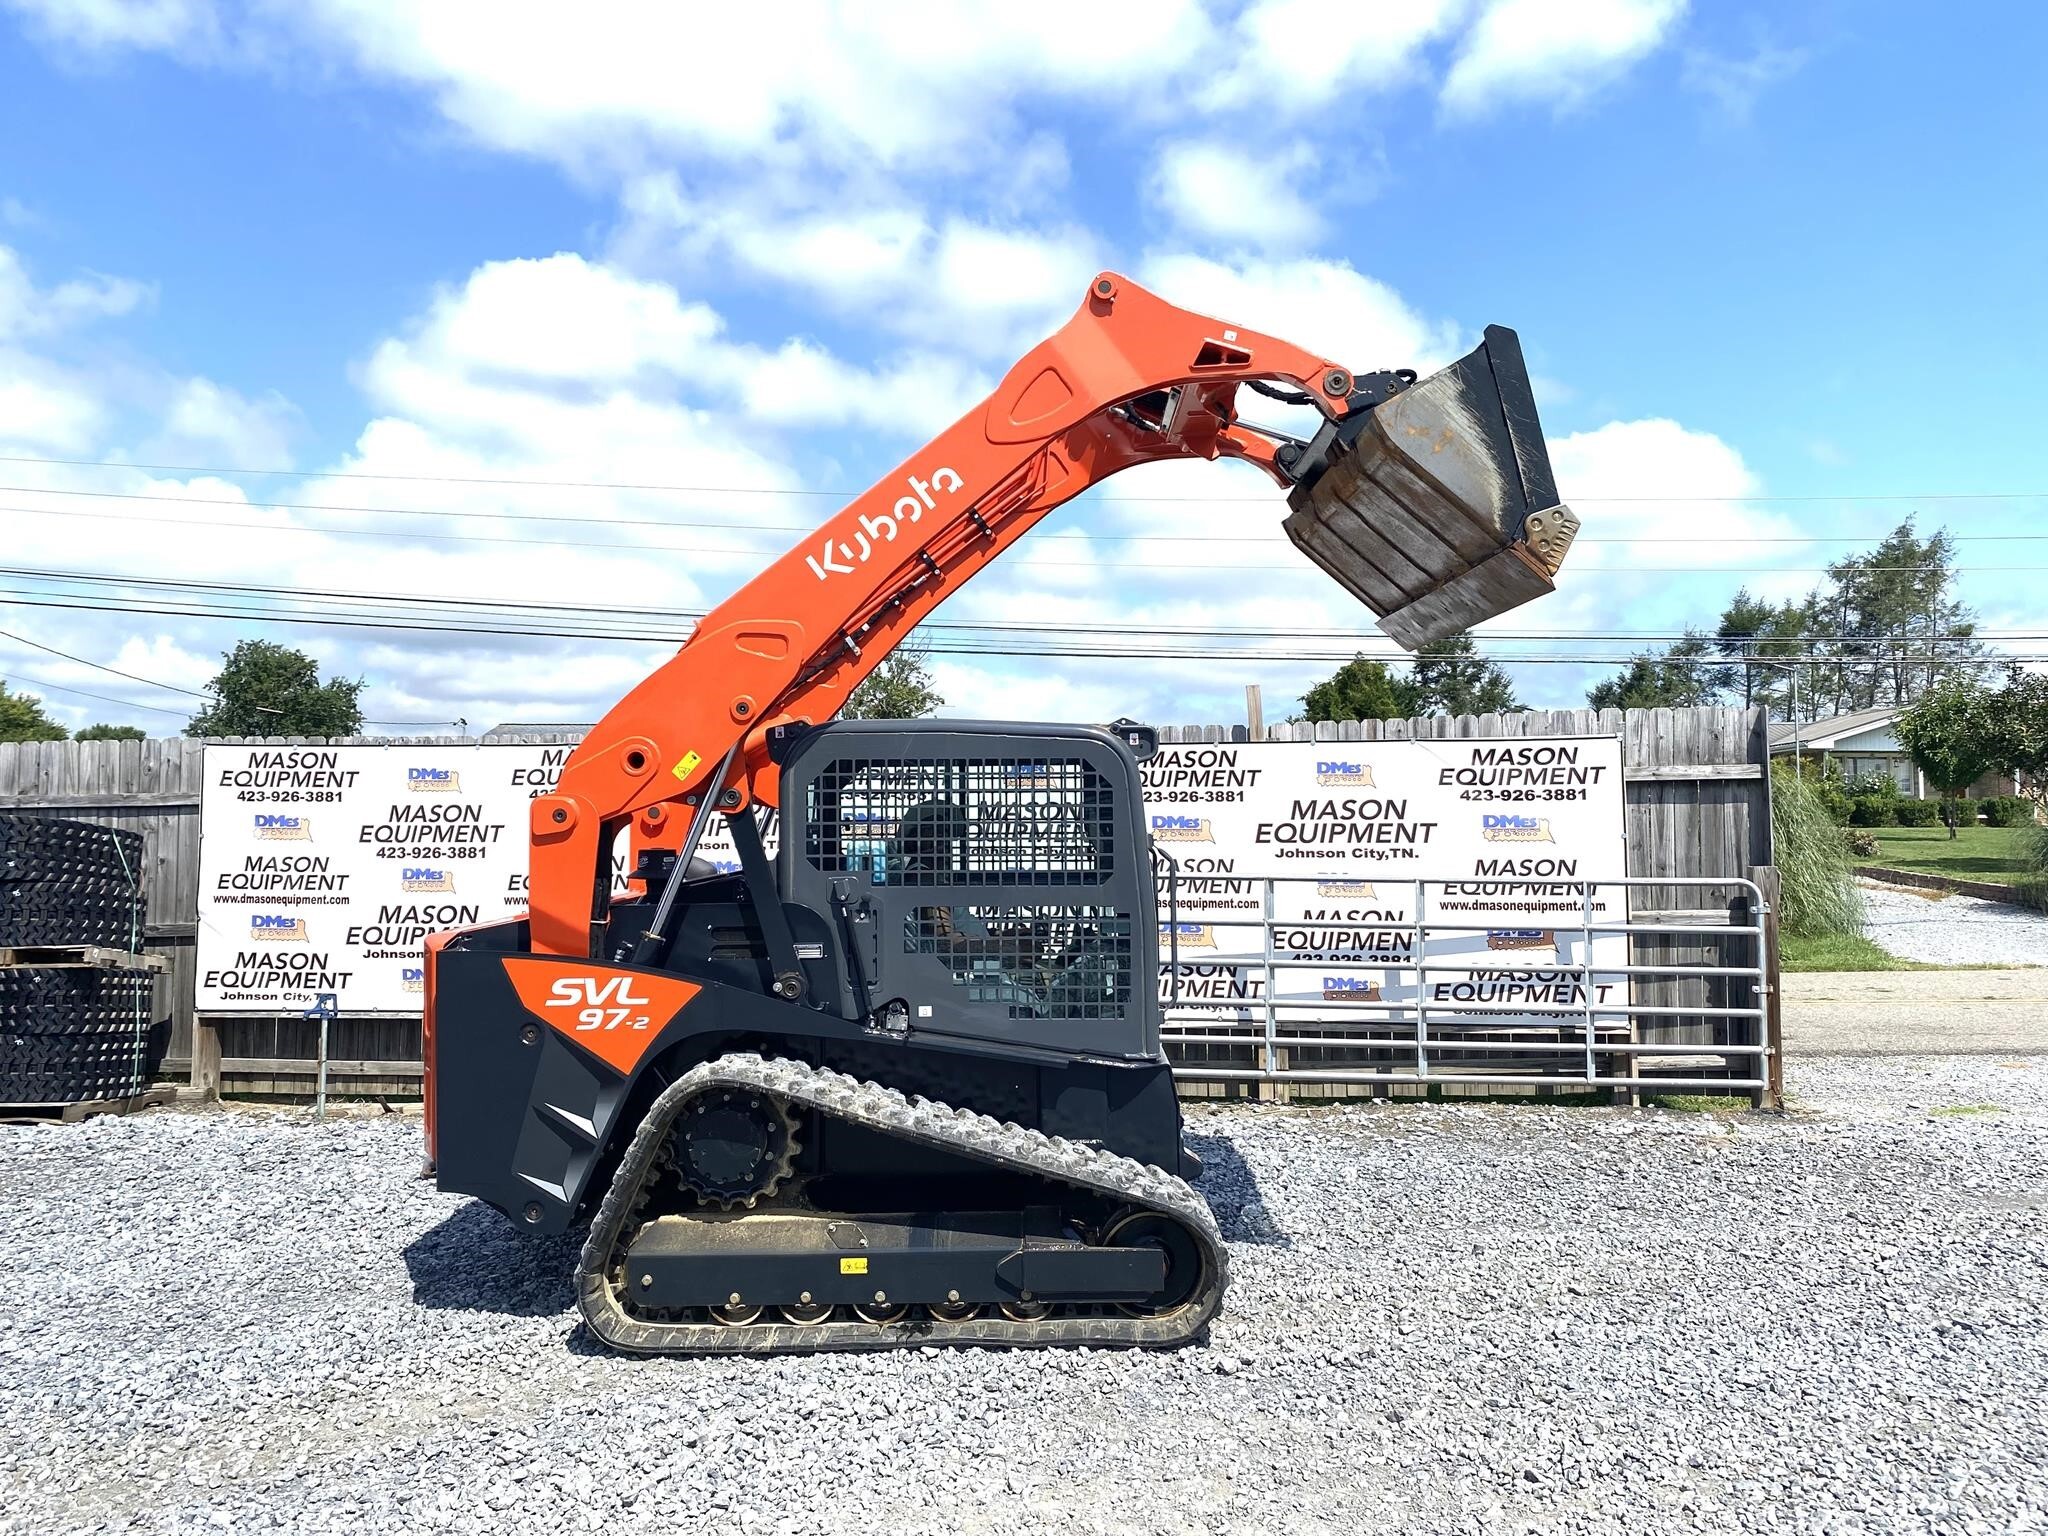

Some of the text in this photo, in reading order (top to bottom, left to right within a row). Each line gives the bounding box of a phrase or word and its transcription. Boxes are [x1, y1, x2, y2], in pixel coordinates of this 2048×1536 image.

[805, 466, 965, 582] Kubota
[248, 752, 338, 769] MASON
[1143, 750, 1238, 768] MASON
[1471, 746, 1578, 766] MASON
[219, 770, 360, 788] EQUIPMENT
[1438, 766, 1607, 787] EQUIPMENT
[237, 790, 343, 803] 423-926-3881
[1143, 790, 1244, 803] 23-926-3881
[1459, 788, 1587, 802] 423-926-3881
[389, 804, 483, 823] MASON
[1290, 799, 1407, 820] MASON
[358, 824, 505, 843] EQUIPMENT
[1255, 822, 1438, 844] EQUIPMENT
[376, 846, 486, 859] 423-926-3881
[1275, 848, 1420, 860] Johnson City,TN.
[244, 855, 330, 873] MASON
[1474, 859, 1577, 877] MASON
[217, 873, 350, 891] EQUIPMENT
[213, 893, 350, 907] www.dmasonequipment.com
[377, 905, 480, 924] MASON
[234, 951, 329, 970] MASON
[363, 949, 425, 959] Johnson
[203, 970, 353, 989] EQUIPMENT
[219, 991, 278, 1001] Johnson
[544, 976, 650, 1007] SVL
[1433, 983, 1613, 1004] EQUIPMENT
[575, 1008, 651, 1031] 97-2
